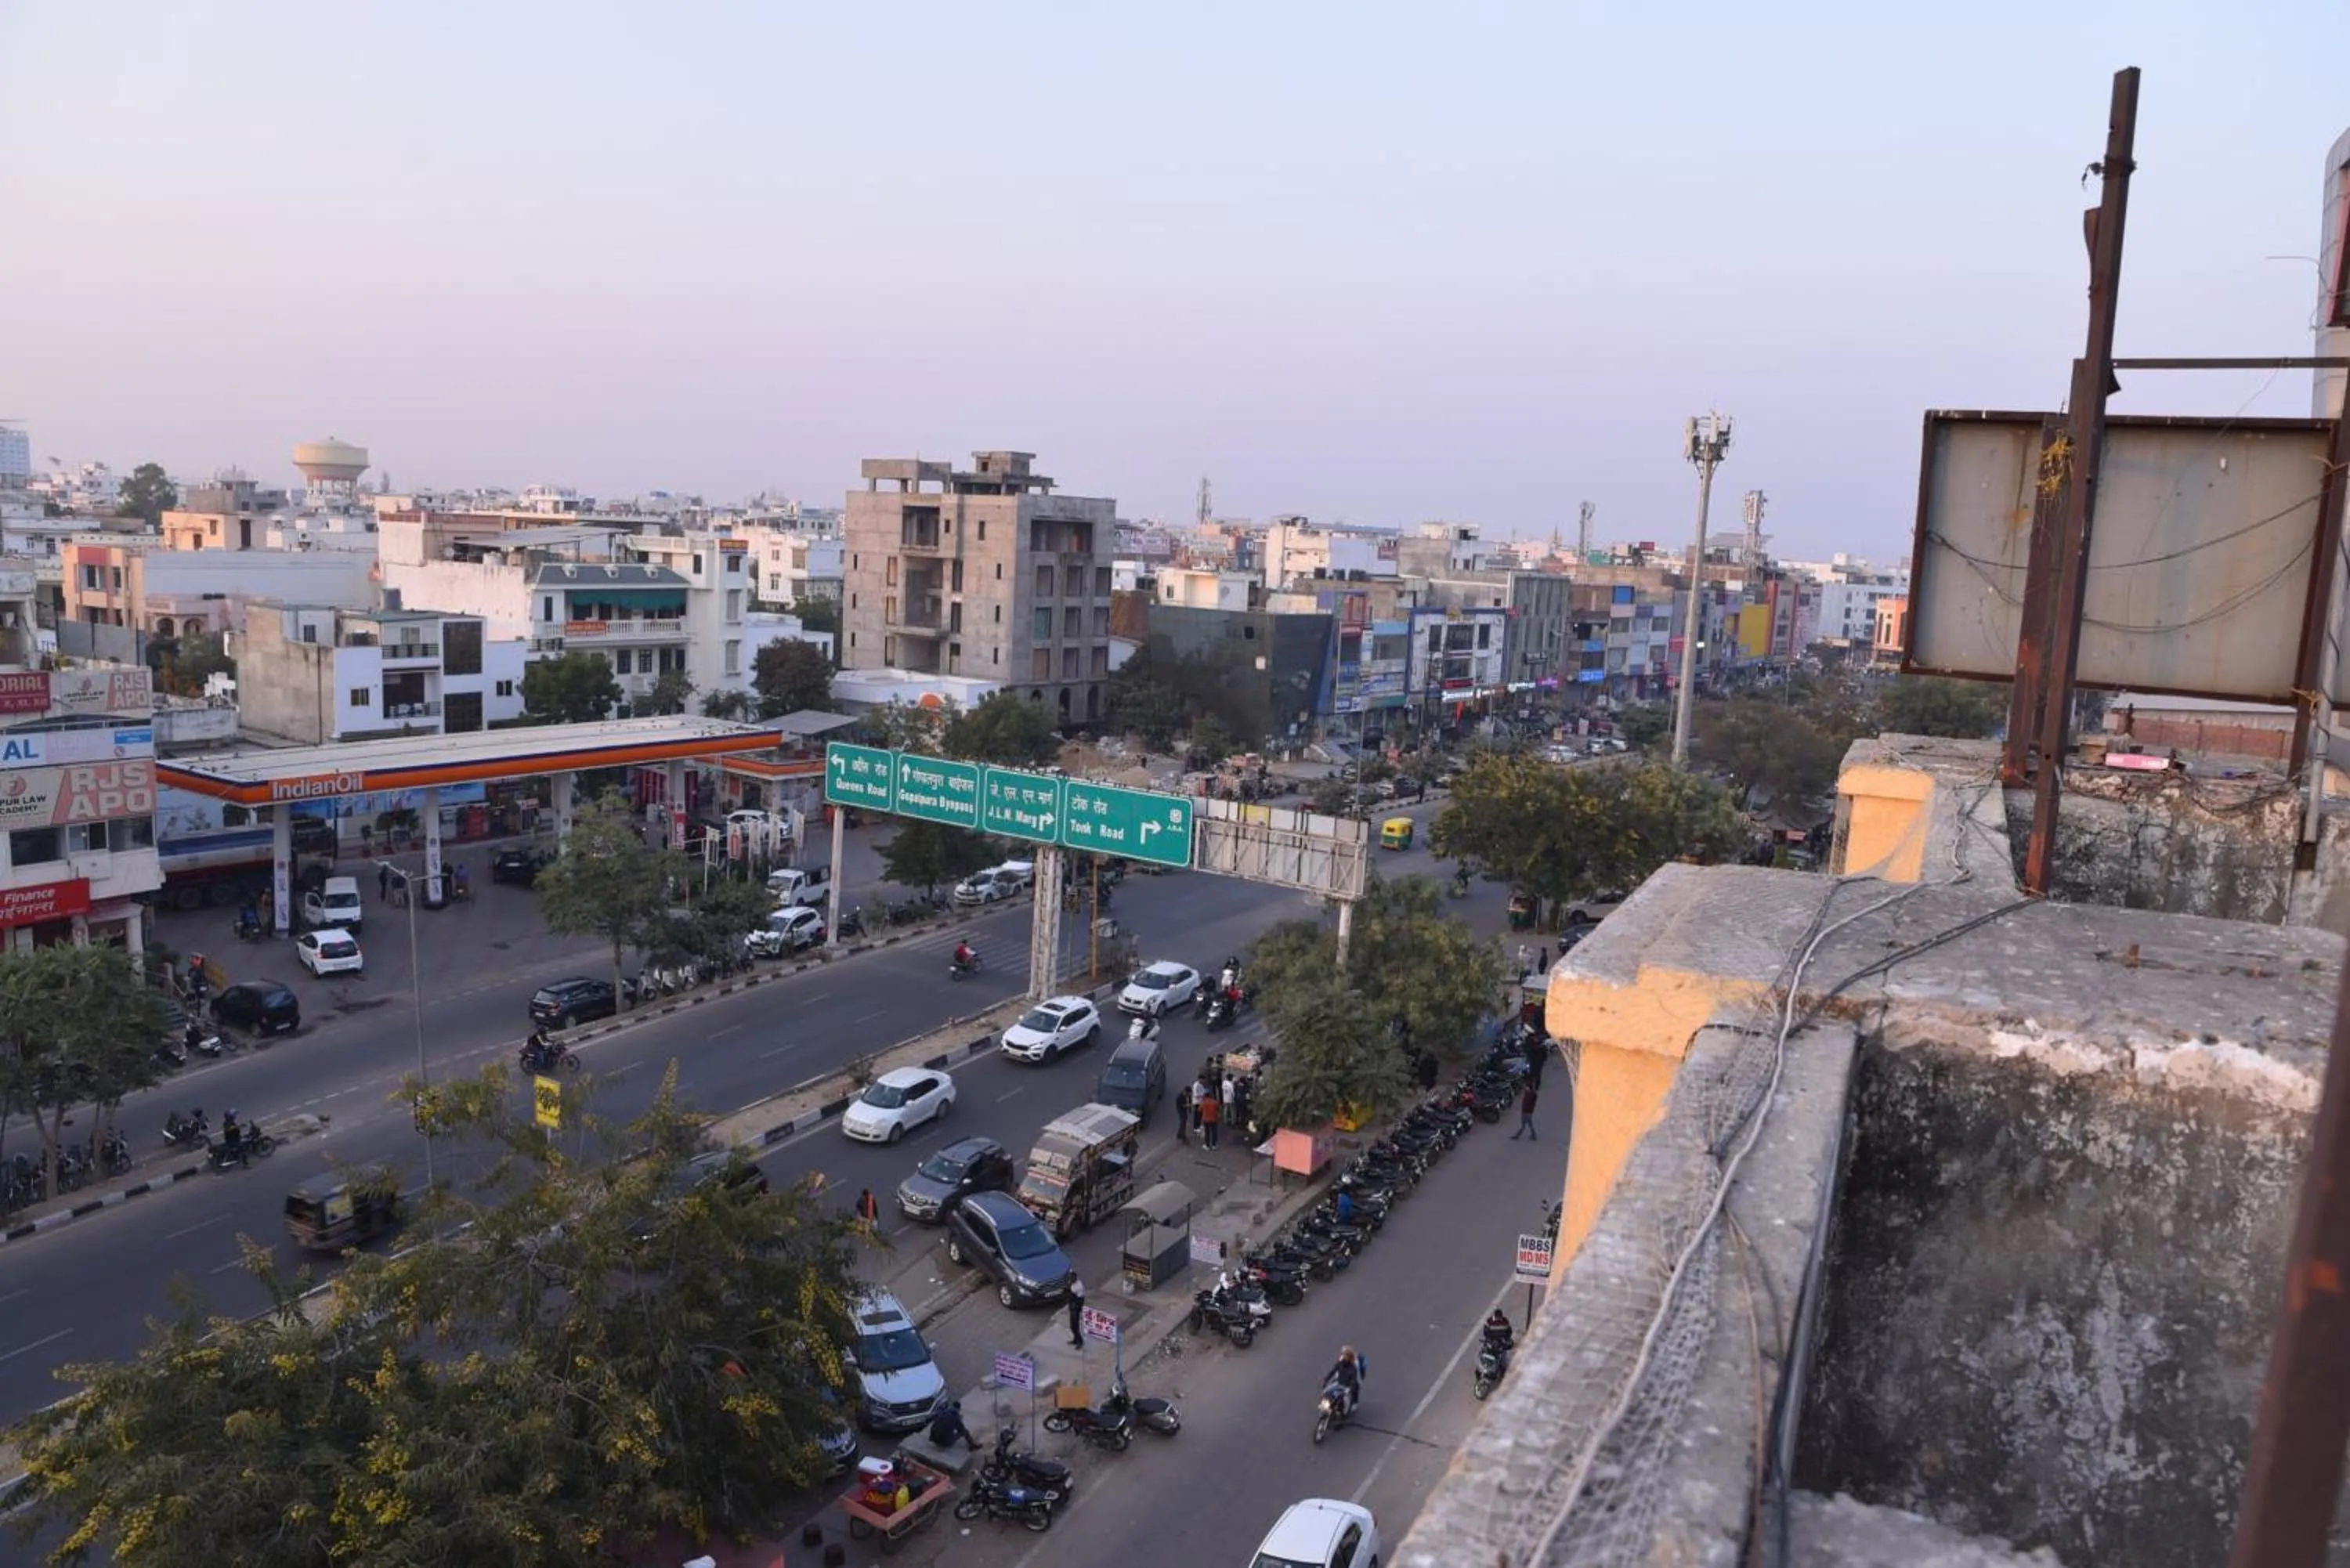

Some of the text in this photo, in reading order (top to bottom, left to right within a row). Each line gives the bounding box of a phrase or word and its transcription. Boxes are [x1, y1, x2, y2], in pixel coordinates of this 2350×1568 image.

[114, 674, 144, 689] RJS
[115, 690, 147, 708] APO
[3, 739, 39, 761] AL
[70, 763, 148, 792] RJS
[272, 772, 364, 800] IndianOil
[836, 777, 887, 797] Queens Road
[23, 794, 47, 804] LAW
[68, 789, 151, 821] APO
[1094, 797, 1108, 815] रोड
[1016, 810, 1037, 829] Marg
[1070, 818, 1124, 840] Tonk Road
[5, 888, 56, 905] Finance
[1520, 1237, 1550, 1252] MBBS
